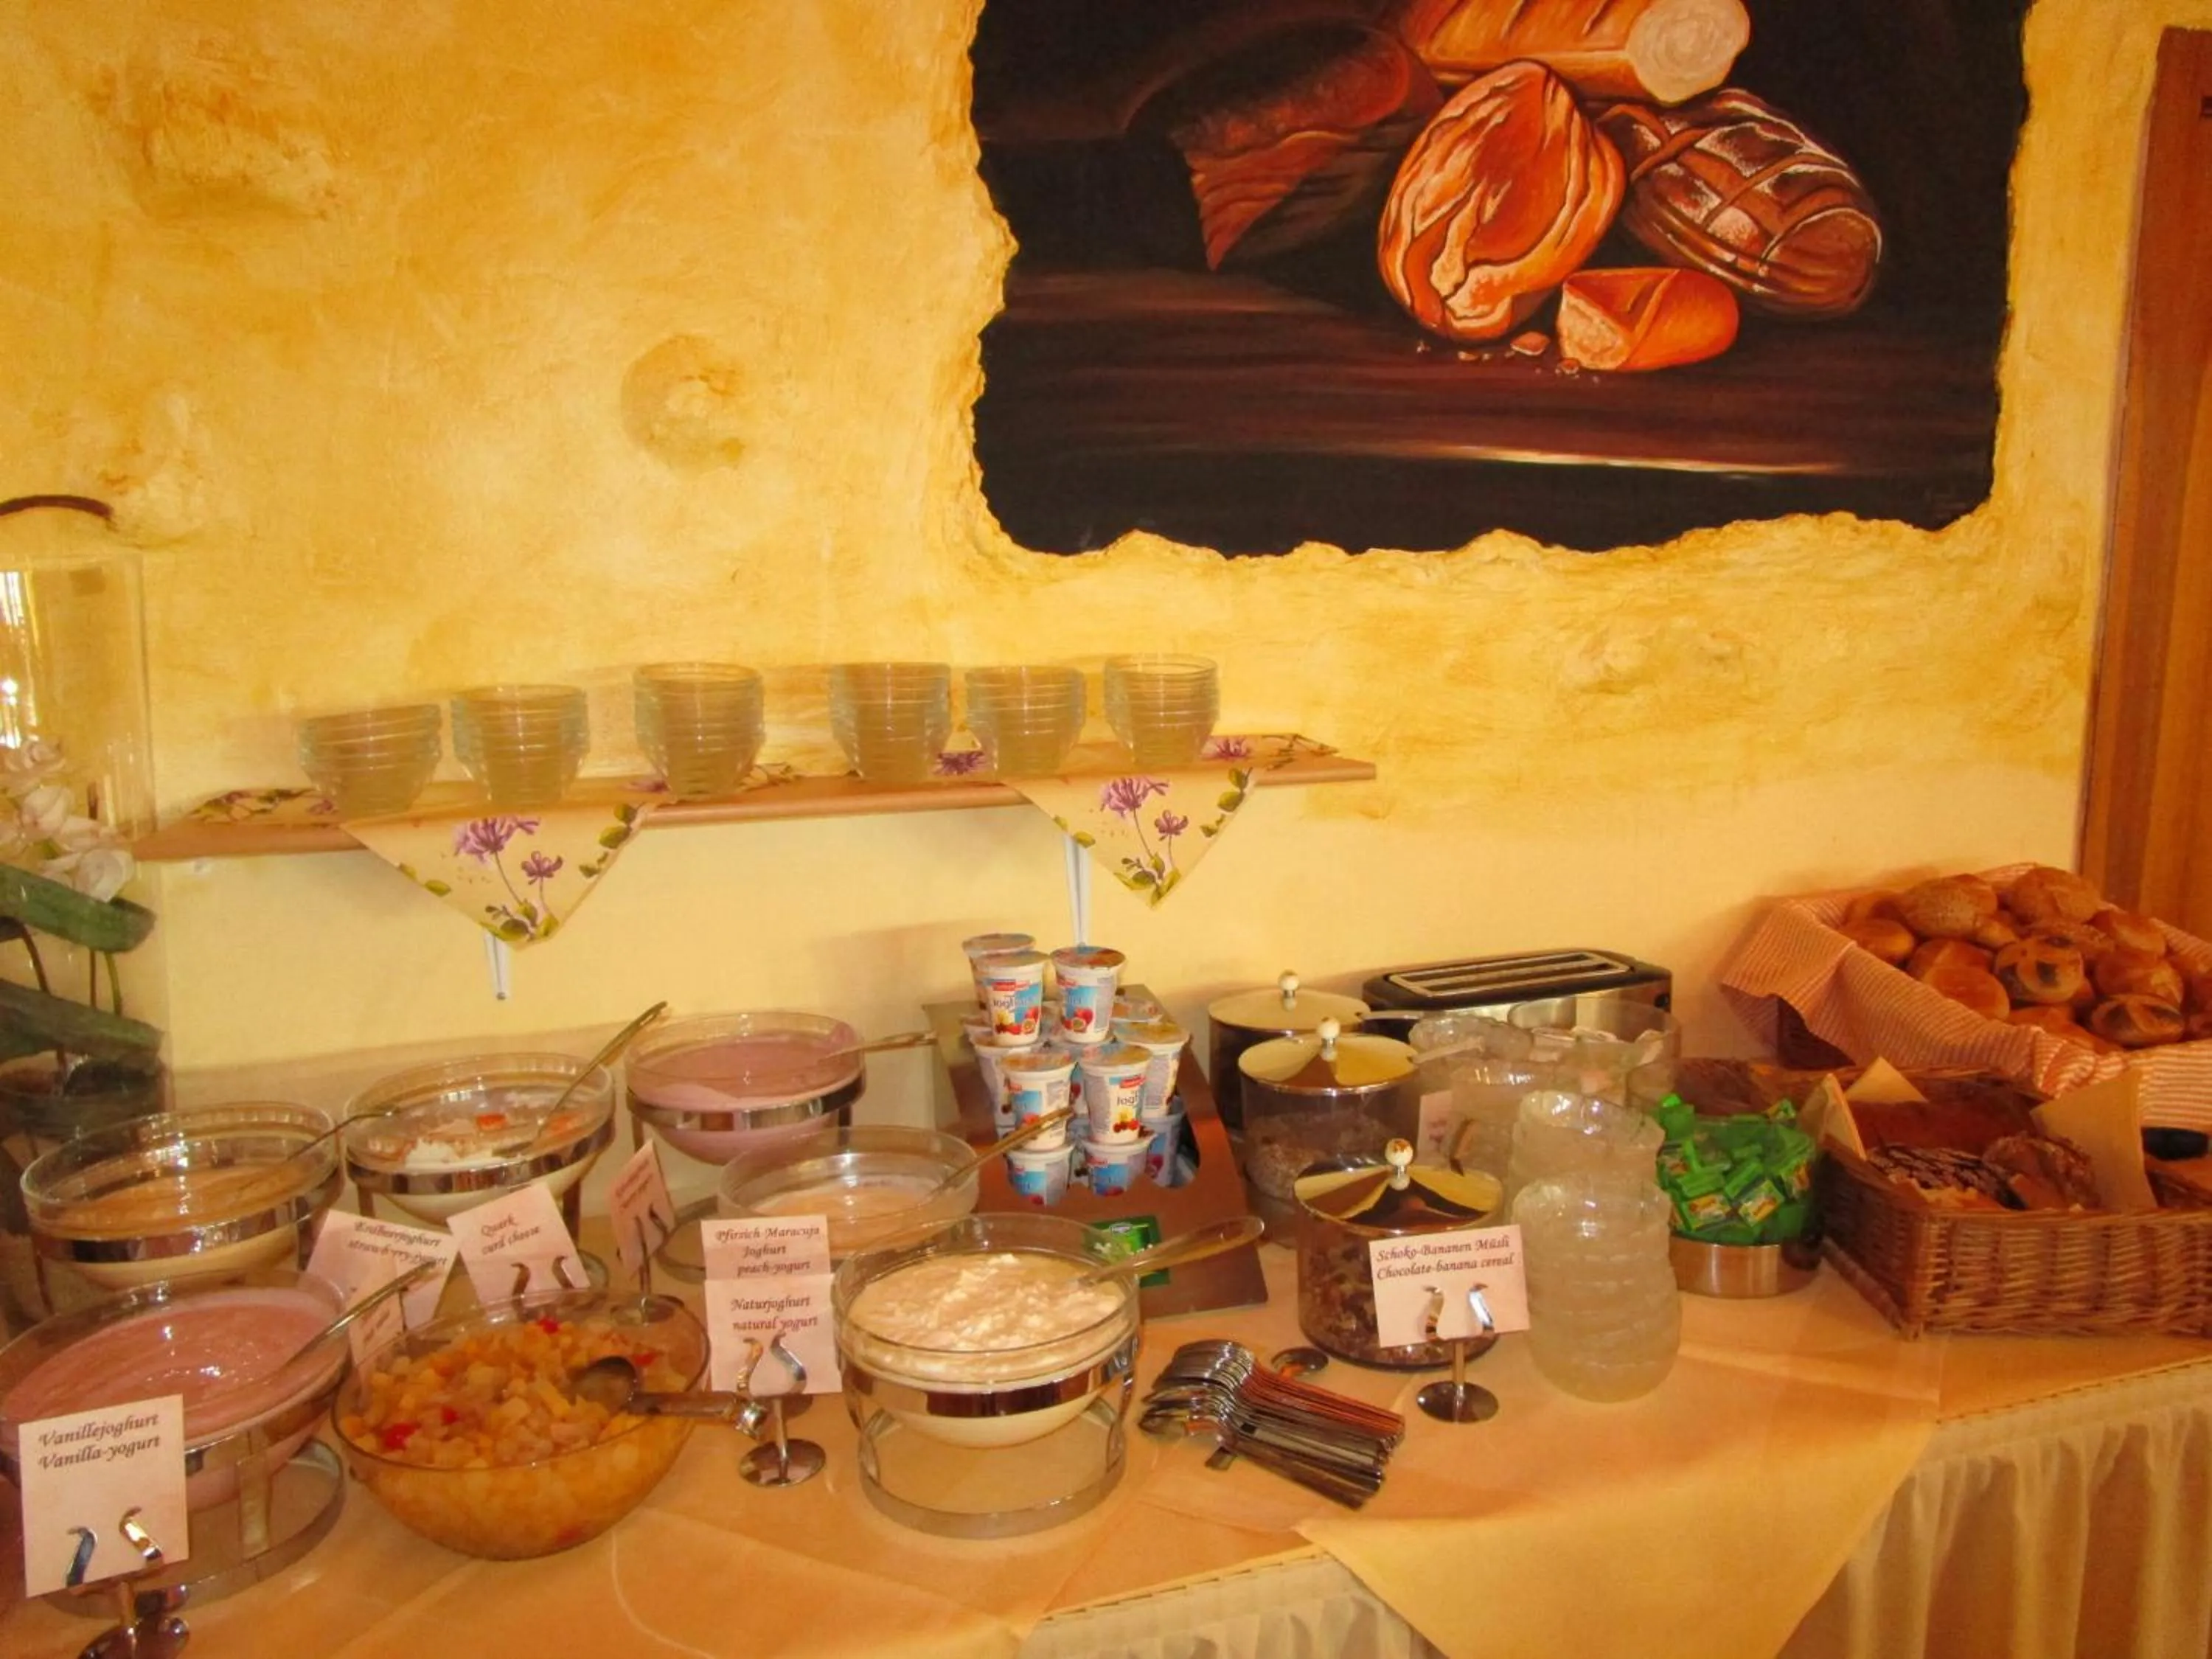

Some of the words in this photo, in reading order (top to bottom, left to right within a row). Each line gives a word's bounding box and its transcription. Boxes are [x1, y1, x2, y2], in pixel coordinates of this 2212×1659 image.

[716, 1228, 760, 1242] Pfirsich
[765, 1227, 820, 1240] Maracuja
[743, 1245, 787, 1258] Joghurt
[1377, 1242, 1472, 1261] Schoko-Bananen
[1481, 1252, 1515, 1268] cereal
[731, 1295, 811, 1313] Naturjoghurt
[732, 1316, 777, 1330] natural
[780, 1315, 818, 1333] yogurt
[39, 1413, 159, 1447] Vanillejoghurt
[38, 1436, 161, 1470] Vanilla-yogurt
